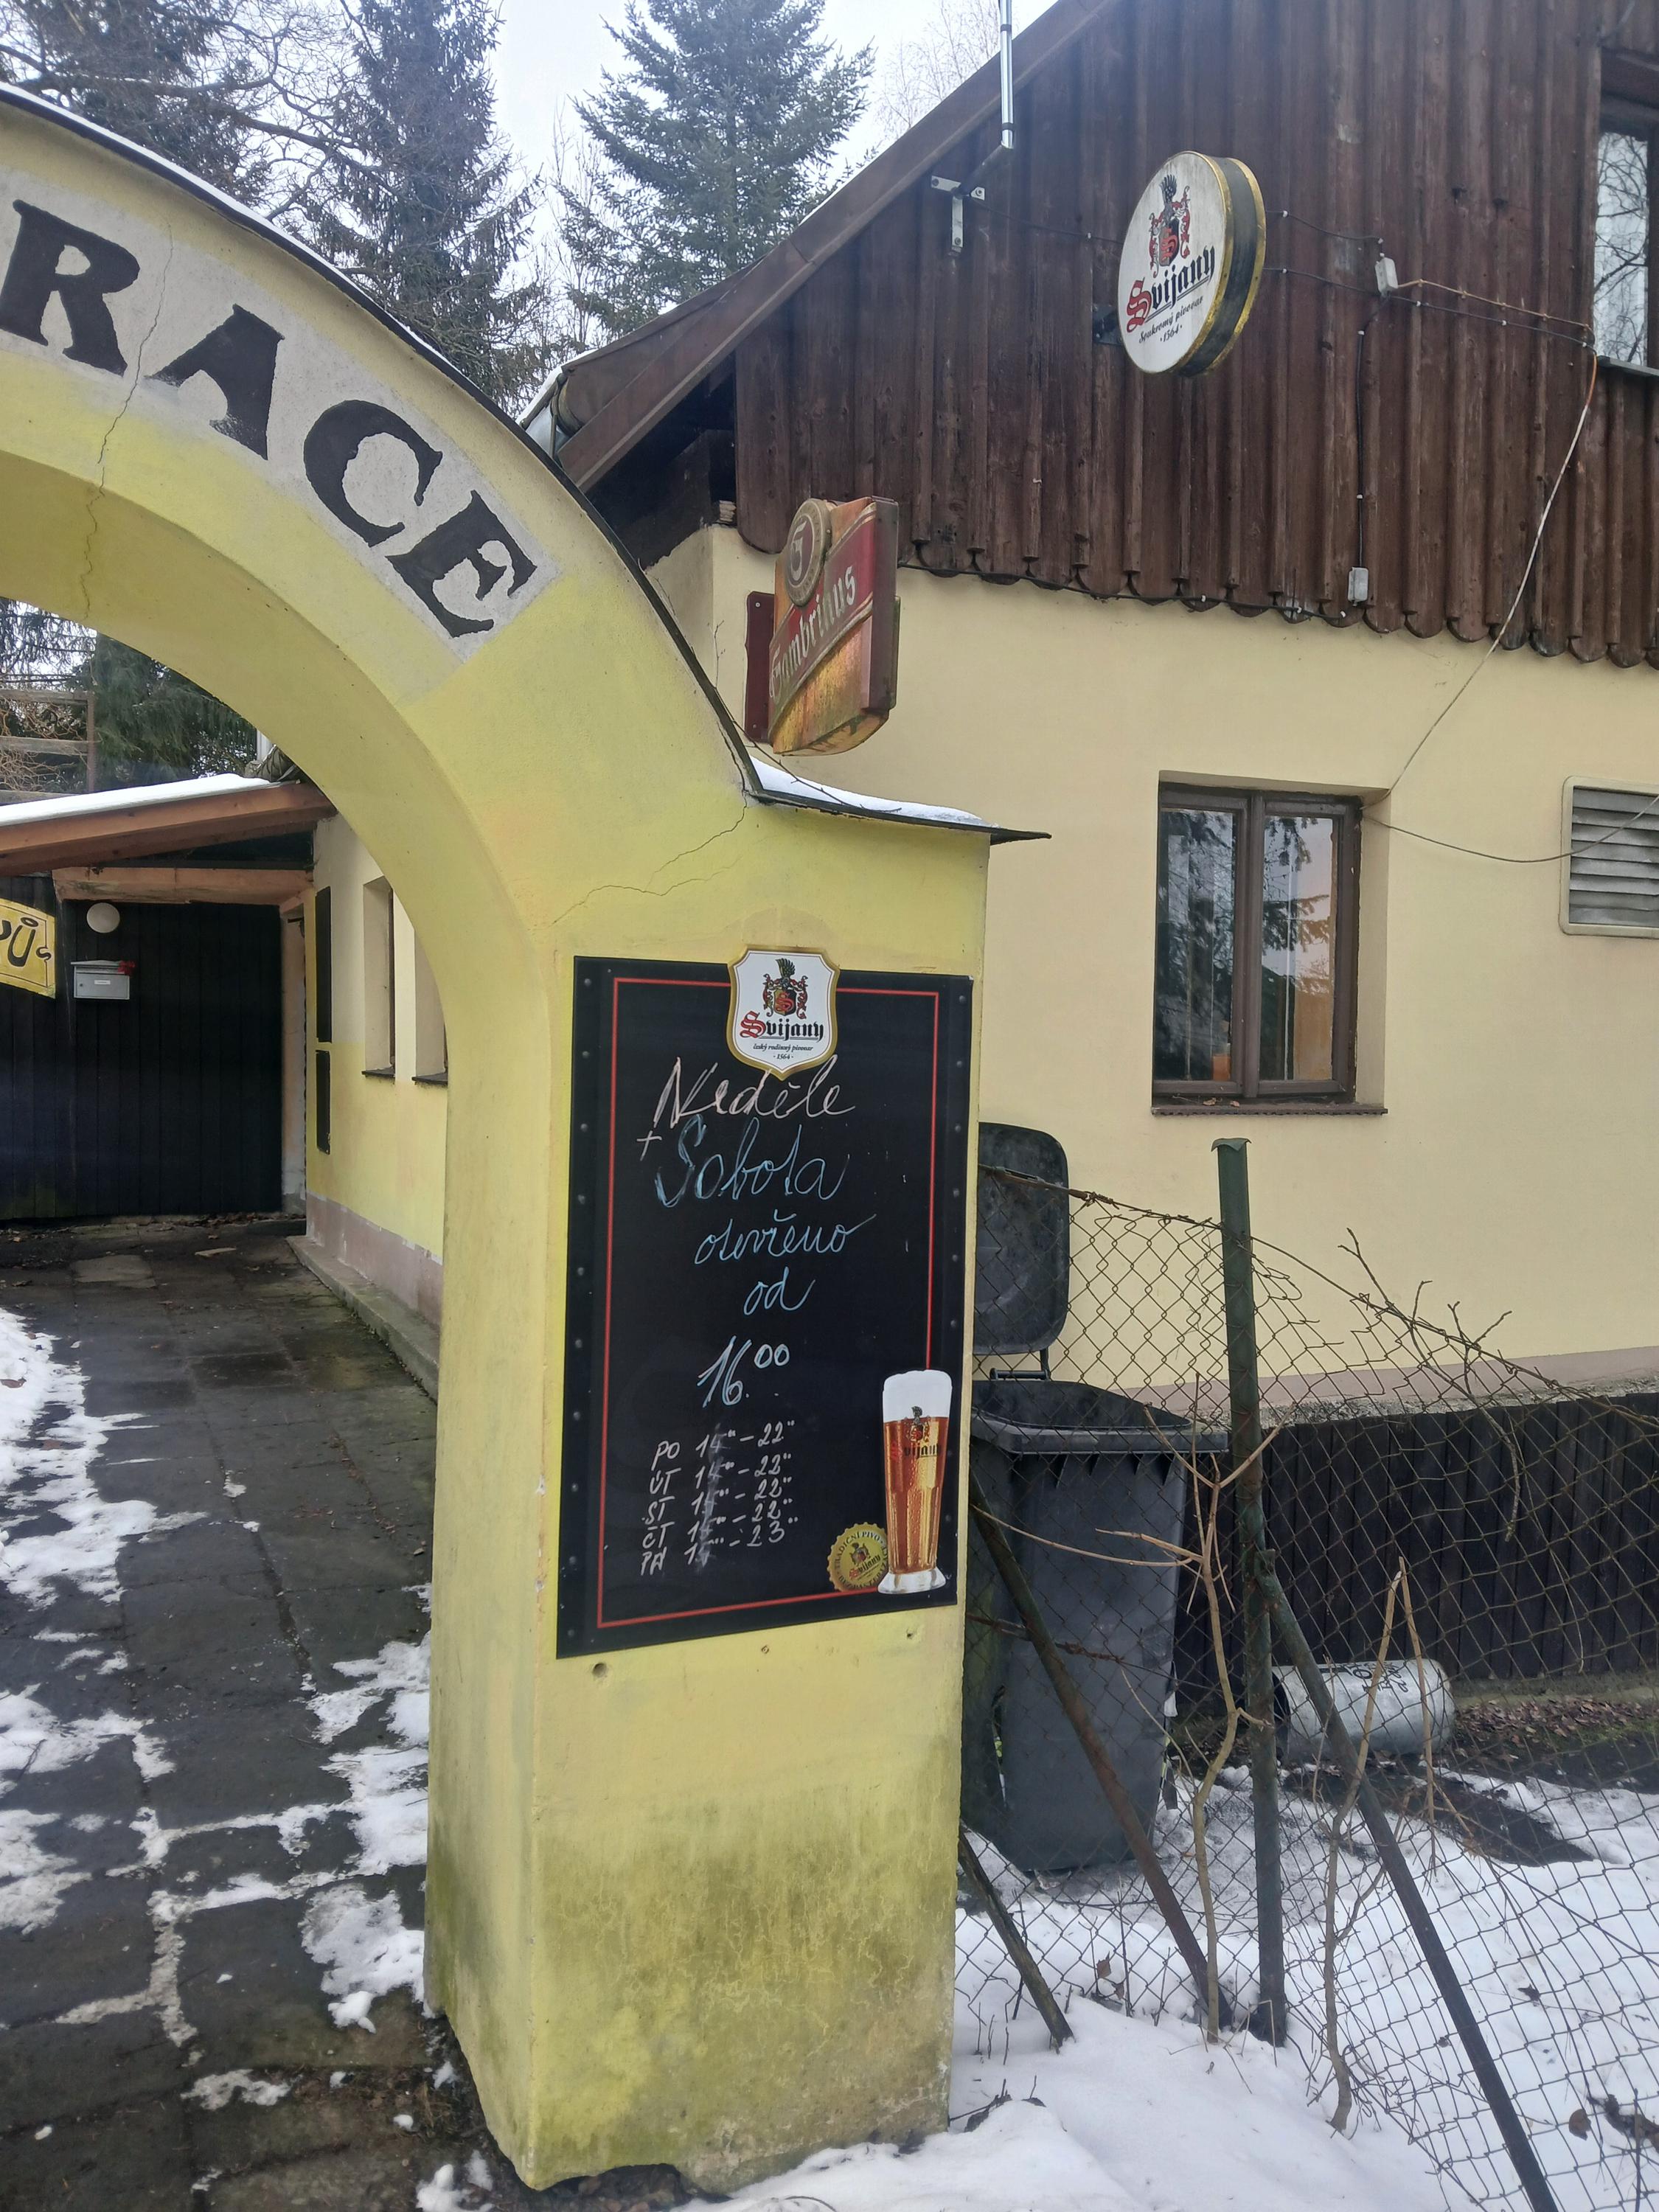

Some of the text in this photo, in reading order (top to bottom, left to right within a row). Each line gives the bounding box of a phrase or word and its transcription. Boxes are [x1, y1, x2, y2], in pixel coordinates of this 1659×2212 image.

[1126, 245, 1216, 333] Svijany
[1175, 296, 1203, 322] pivovar
[0, 199, 538, 639] RACE
[740, 1010, 824, 1043] Svijany
[790, 1044, 814, 1053] pivovar
[653, 1054, 856, 1129] Neděle
[742, 1265, 816, 1315] od
[651, 1440, 681, 1472] PO
[649, 1467, 682, 1495] ÚT
[644, 1495, 676, 1526] ST
